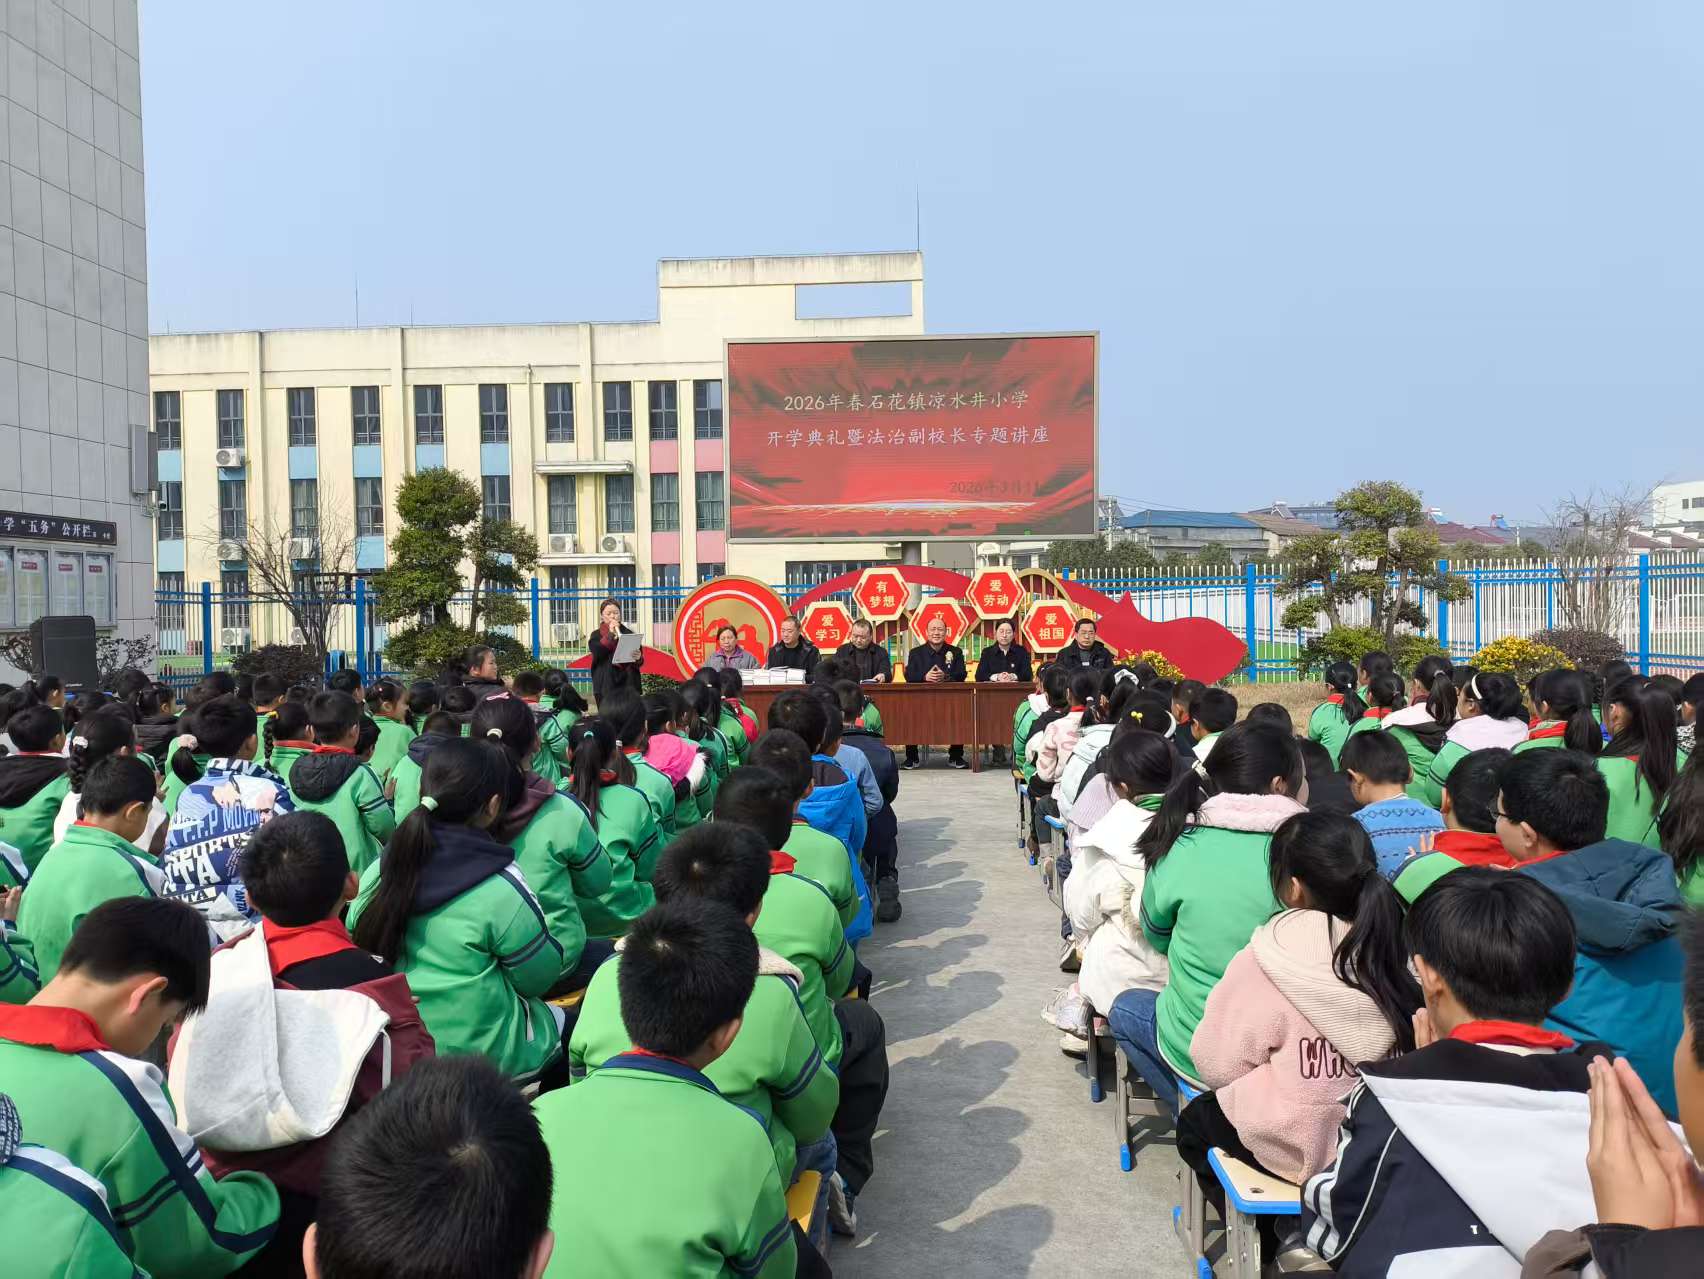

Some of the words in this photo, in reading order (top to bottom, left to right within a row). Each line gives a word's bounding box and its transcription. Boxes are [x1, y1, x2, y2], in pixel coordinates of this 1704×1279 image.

[784, 391, 1029, 412] 2026年春石花镇凉水井小学
[767, 425, 1049, 448] 开学典礼暨法治副校长专题讲座
[876, 581, 888, 593] 有
[989, 579, 1002, 592] 爱
[870, 595, 895, 608] 梦想
[983, 594, 1009, 607] 劳动
[821, 614, 834, 627] 爱
[1045, 612, 1058, 625] 爱
[815, 629, 840, 642] 学习
[1039, 627, 1065, 640] 祖国
